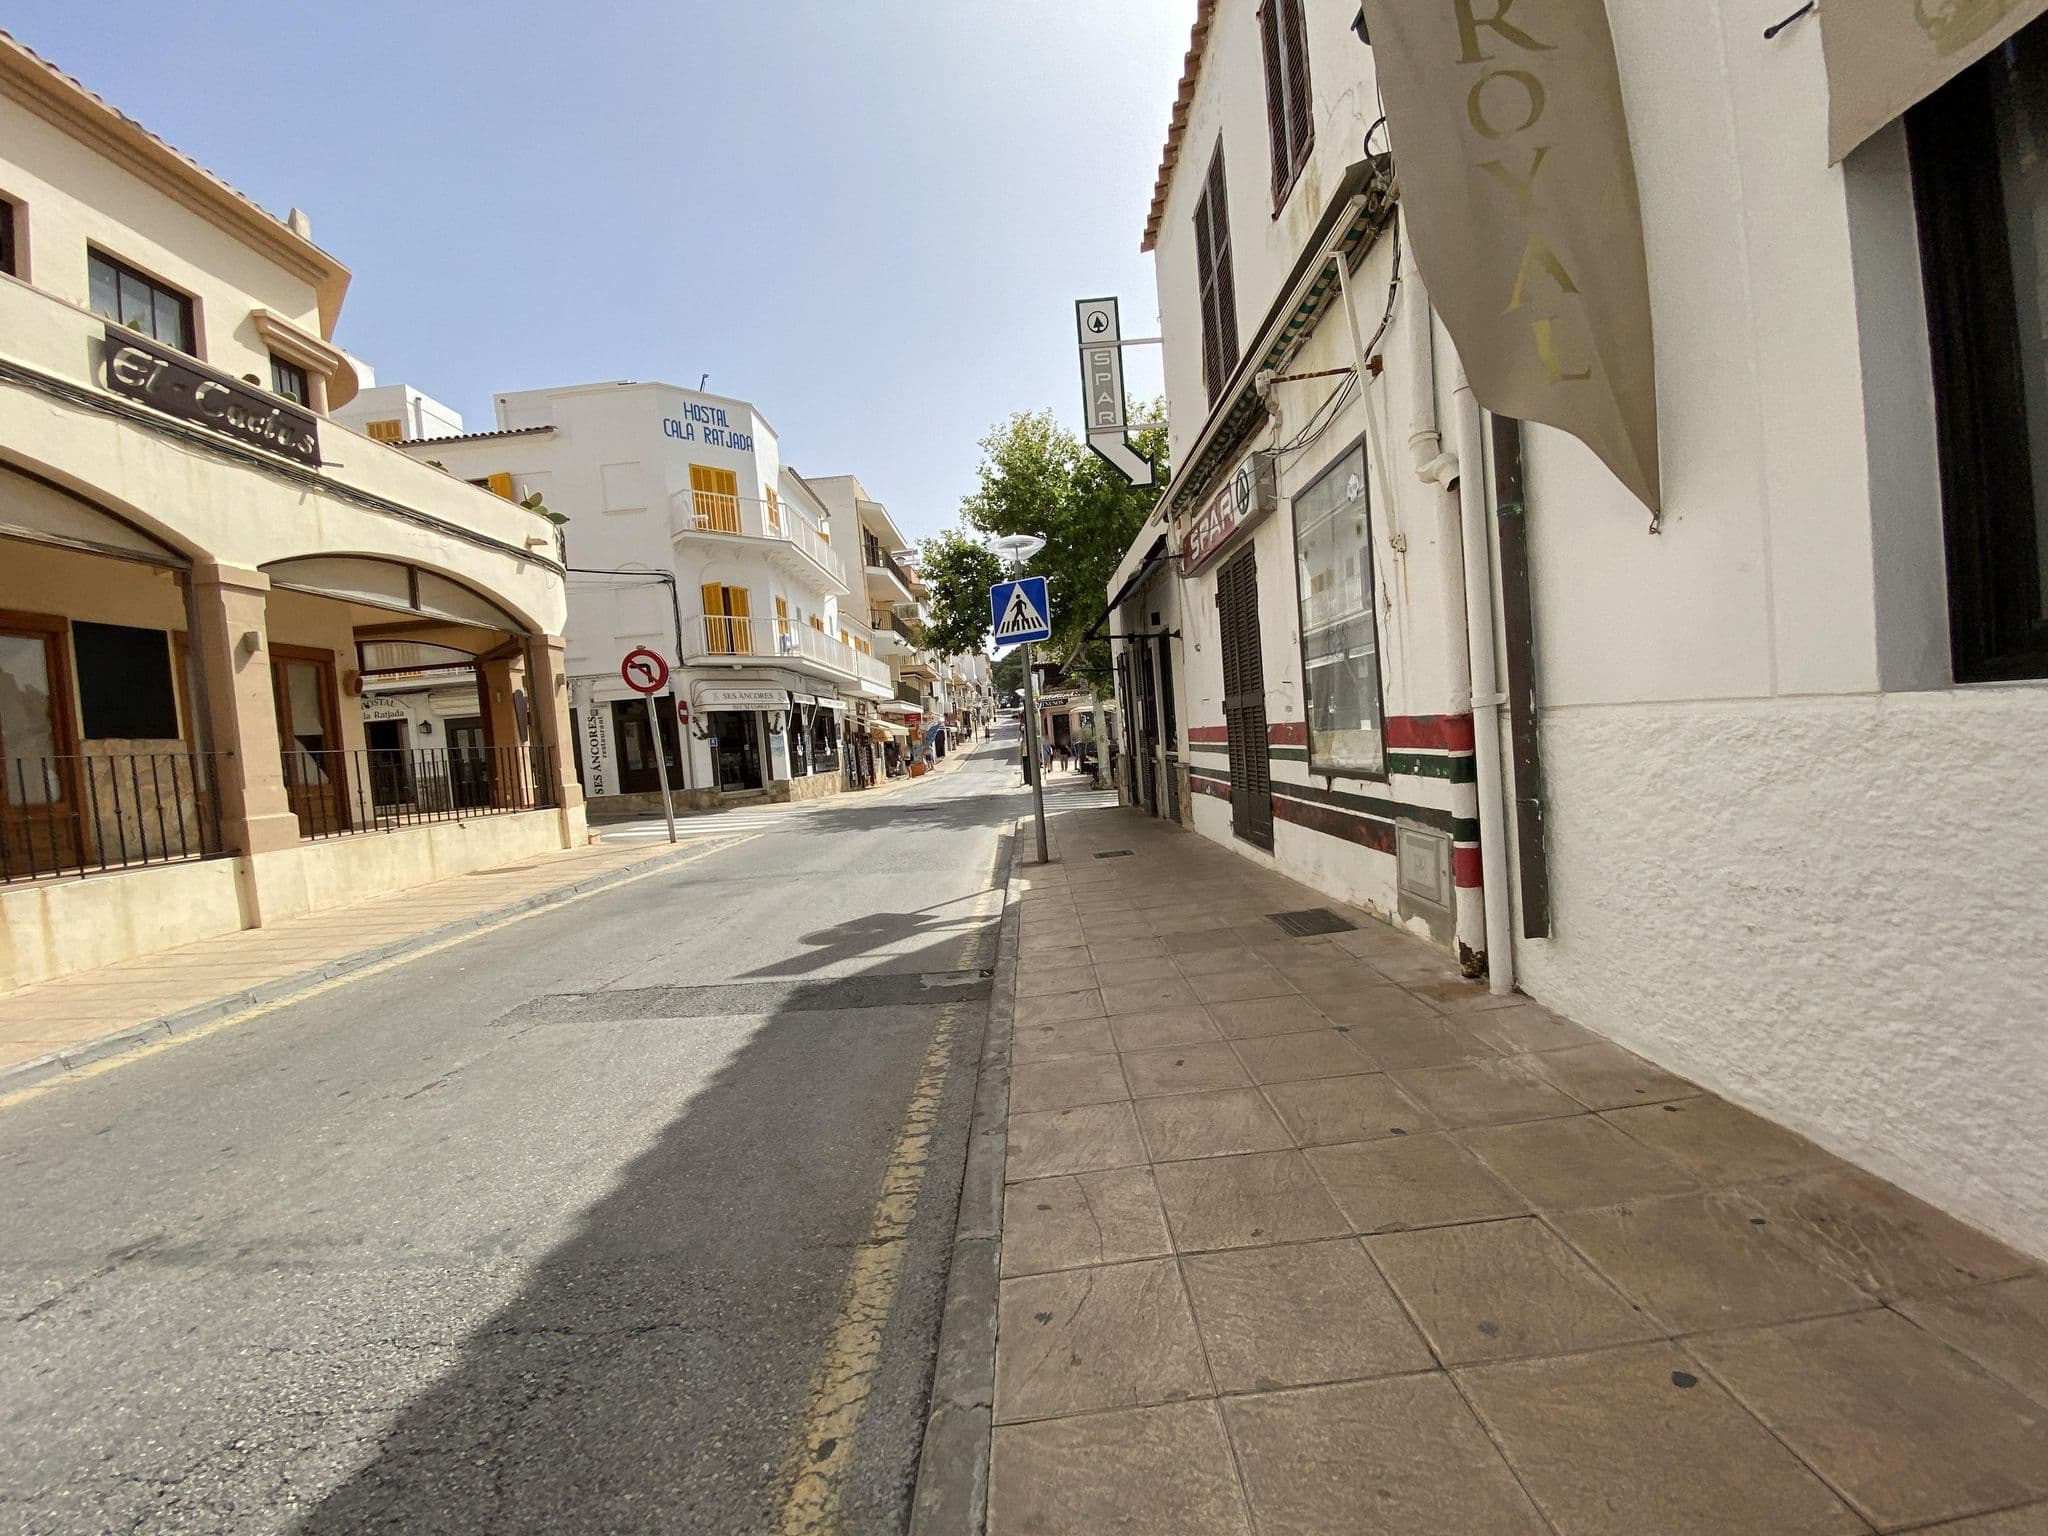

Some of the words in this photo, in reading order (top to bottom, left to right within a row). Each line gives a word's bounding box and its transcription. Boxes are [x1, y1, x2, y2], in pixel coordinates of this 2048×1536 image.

[1455, 0, 1591, 383] ROYAL
[1094, 352, 1115, 424] SPAR
[194, 379, 315, 454] Cactus
[663, 419, 695, 441] CALA
[703, 426, 753, 452] RATJADA
[683, 402, 729, 427] HOSTAL
[1190, 490, 1235, 560] SPAR
[363, 712, 371, 720] la
[374, 709, 405, 720] Ratjada
[598, 715, 608, 759] restaurant
[593, 774, 604, 795] SES
